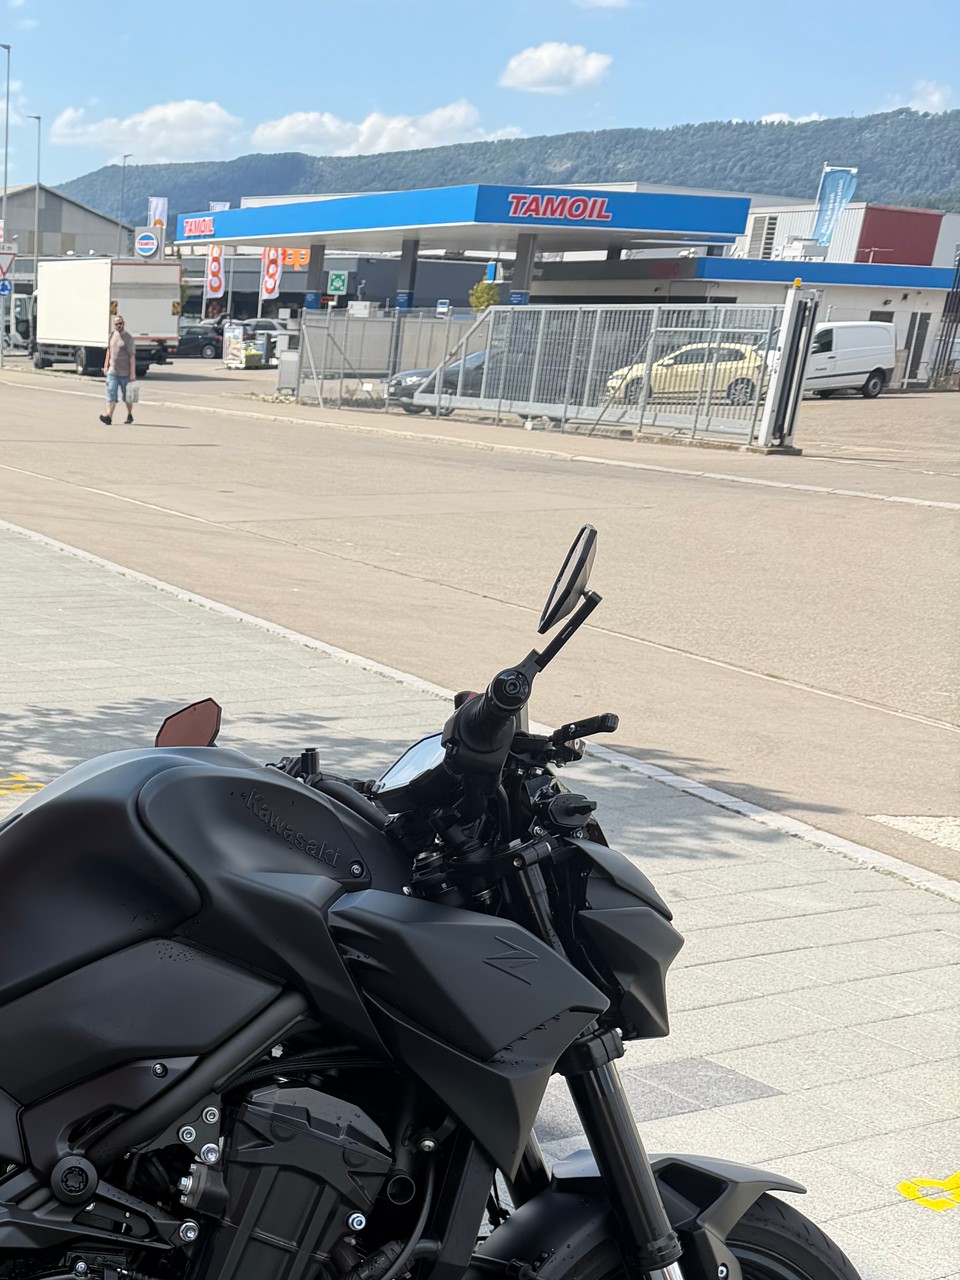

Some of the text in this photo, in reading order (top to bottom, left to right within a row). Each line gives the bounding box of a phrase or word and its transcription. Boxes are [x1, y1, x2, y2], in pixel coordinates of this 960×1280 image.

[508, 194, 613, 221] TAMOIL
[184, 217, 214, 237] TAMOIL
[246, 788, 343, 869] Kawasaki
